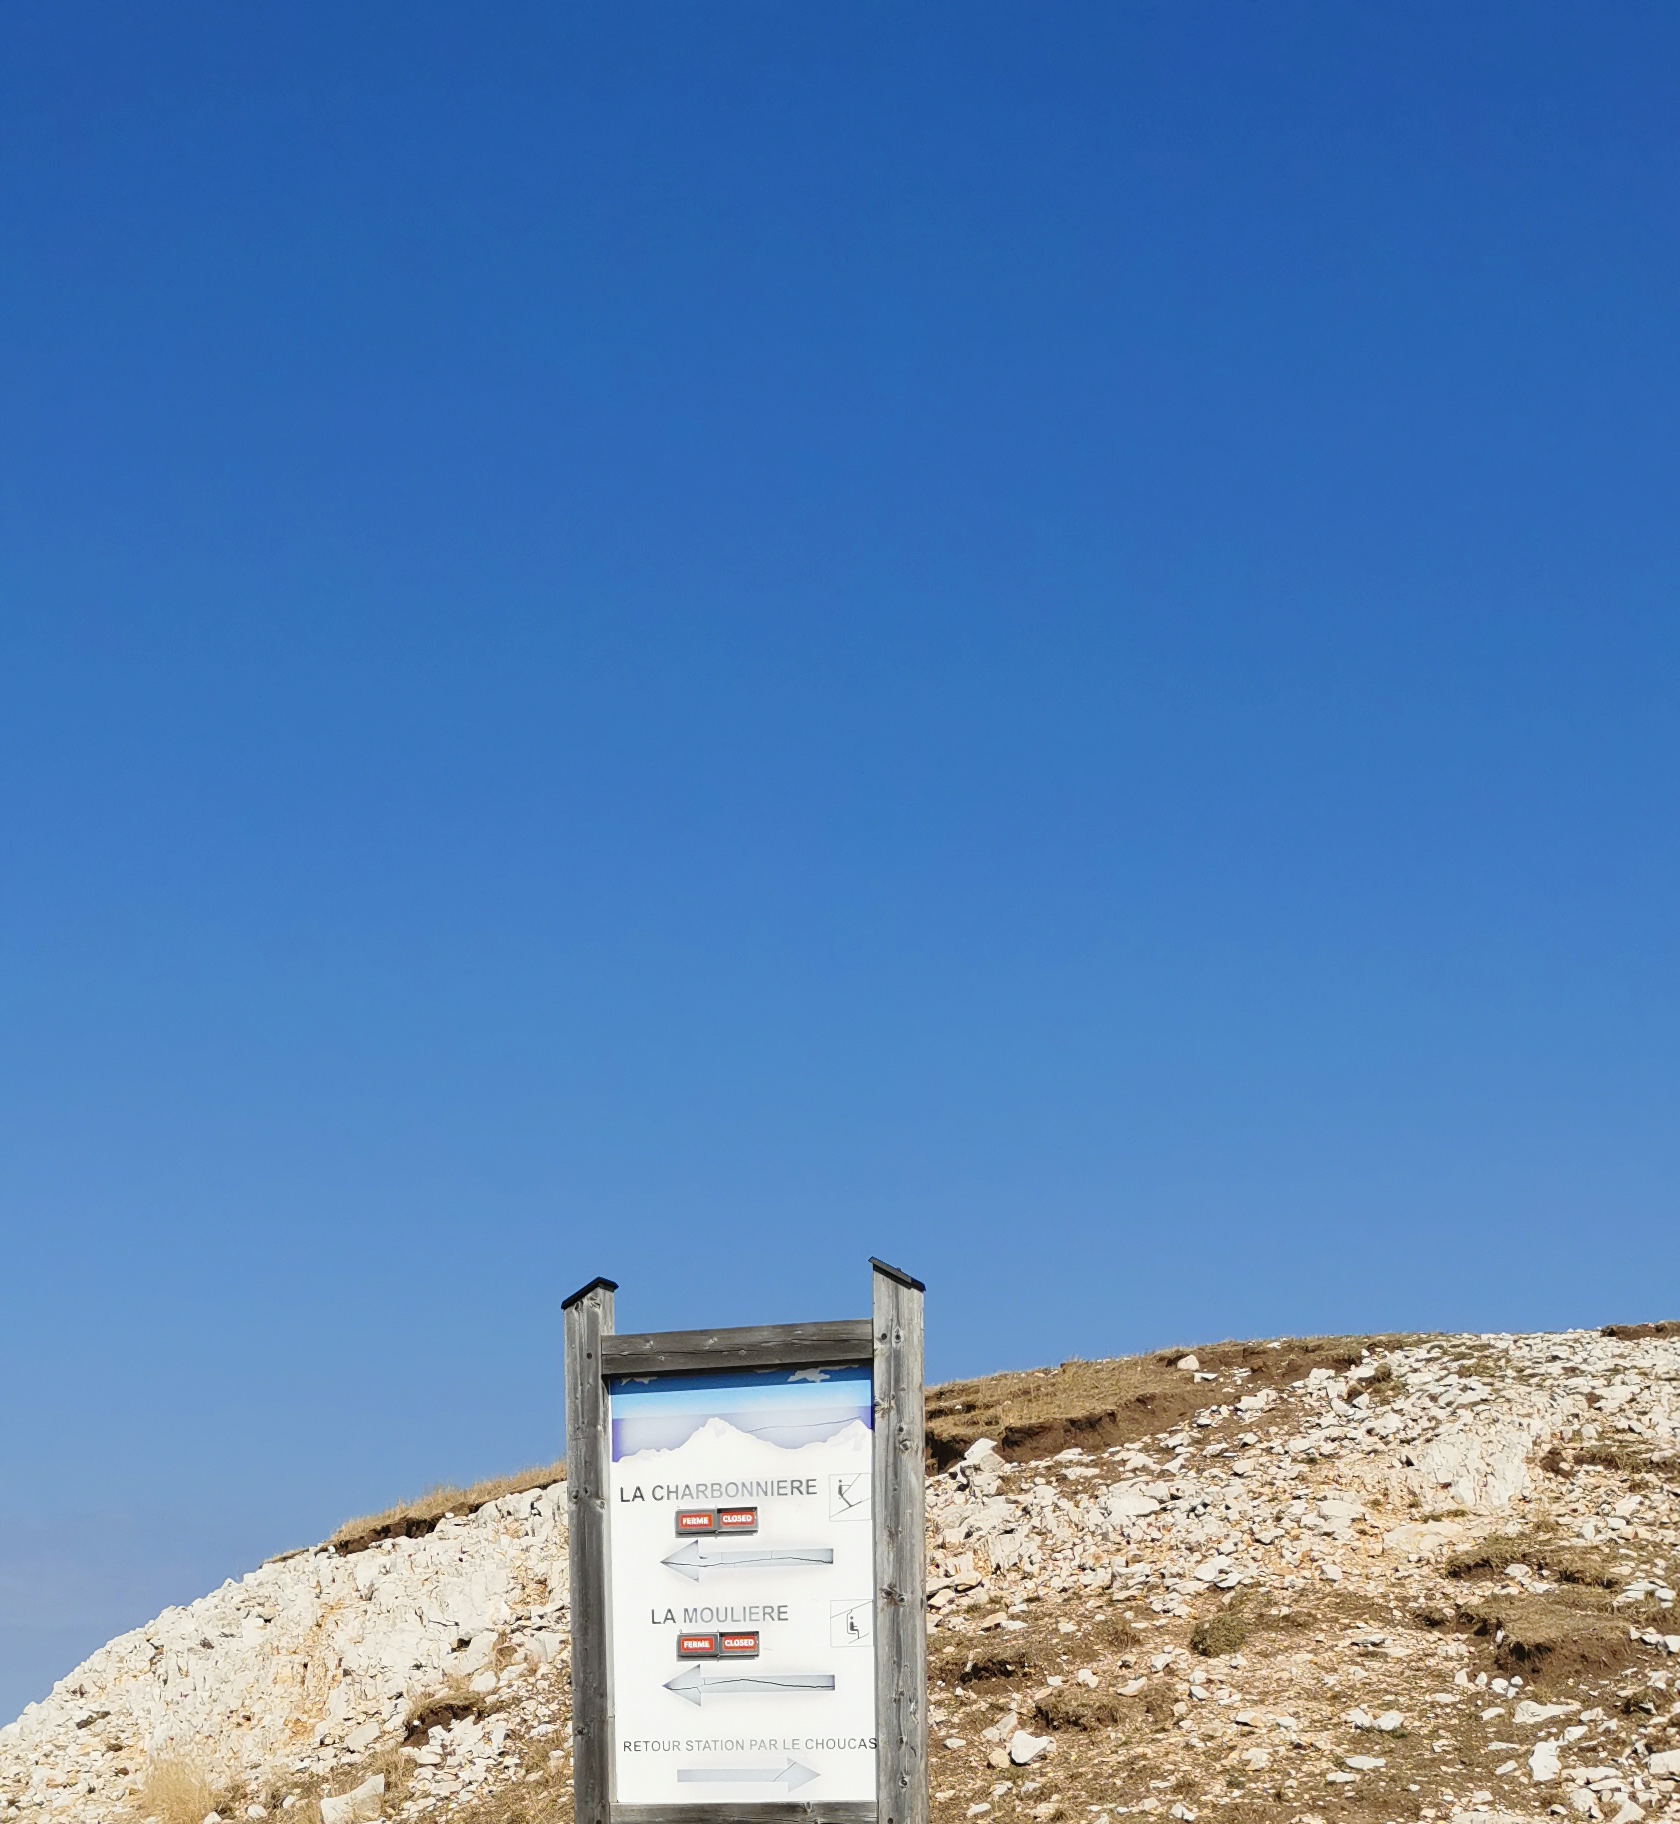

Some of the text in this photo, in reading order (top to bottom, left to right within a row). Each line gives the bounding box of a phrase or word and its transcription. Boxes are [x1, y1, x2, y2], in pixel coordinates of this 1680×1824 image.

[619, 1478, 818, 1503] LA CHARBONNIERE
[682, 1514, 753, 1525] FERME CLOSED
[651, 1604, 789, 1625] LA MOULIERE
[683, 1638, 755, 1649] FERME CLOSED
[623, 1737, 878, 1752] RETOUR STATION PAR LE CHOUCAS
